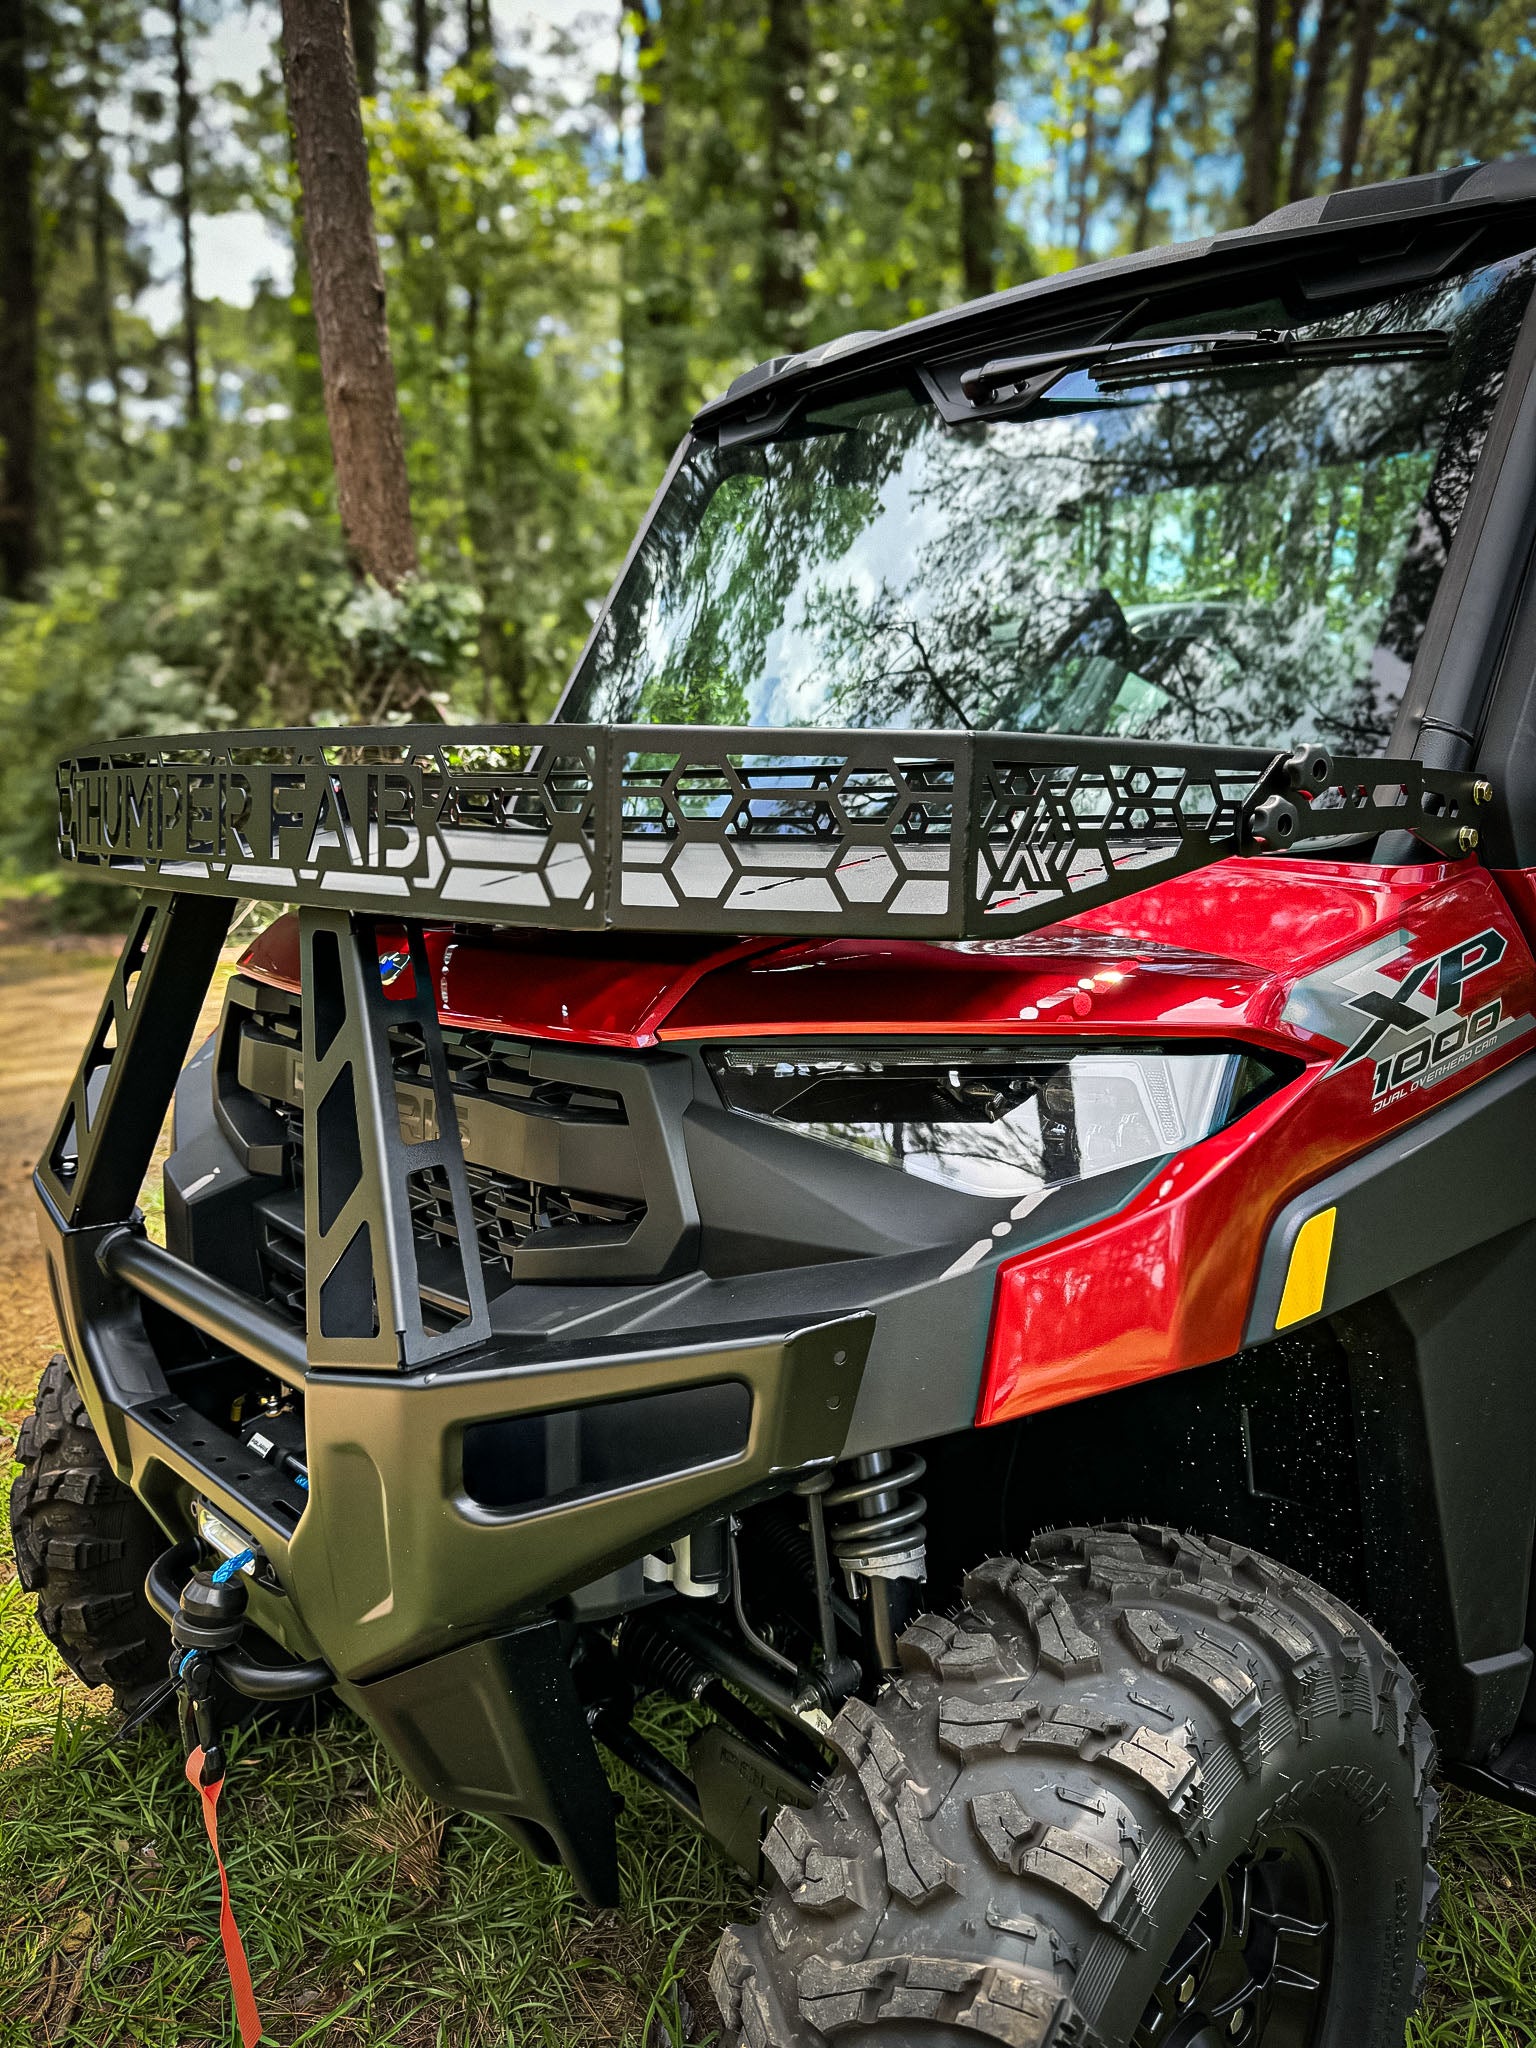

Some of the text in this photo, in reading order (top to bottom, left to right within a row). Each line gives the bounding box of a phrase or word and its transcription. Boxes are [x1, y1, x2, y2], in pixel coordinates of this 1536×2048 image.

[73, 771, 420, 869] THUMPER FAB
[1320, 927, 1508, 1082] XP
[1371, 997, 1503, 1100] 1000
[1373, 1034, 1498, 1113] DUAL OVERHEAD CAM
